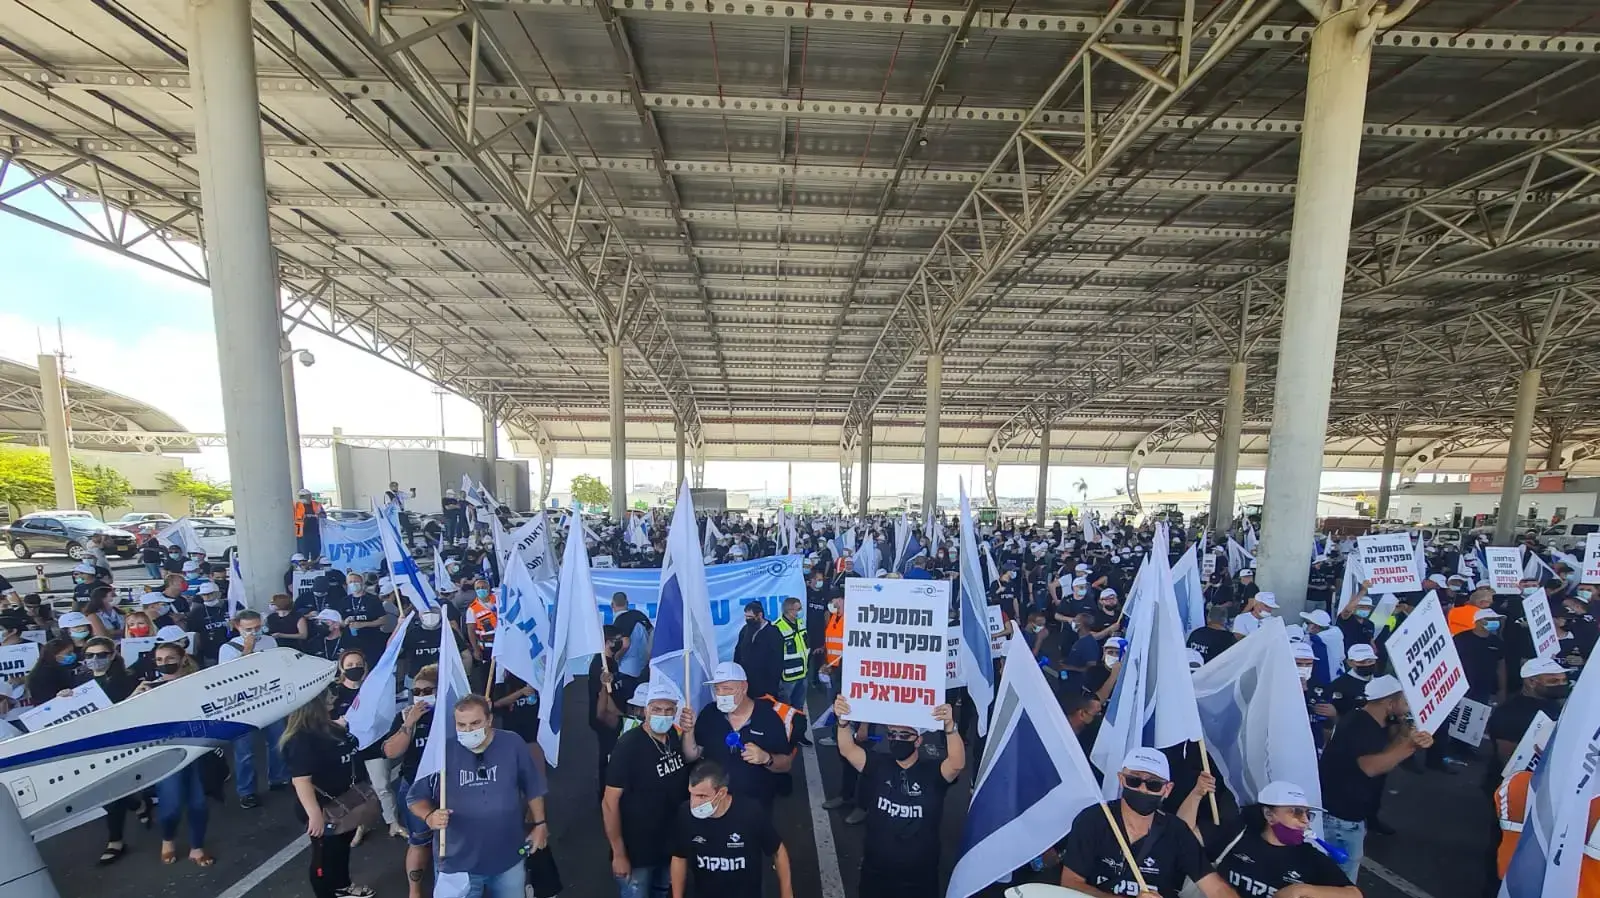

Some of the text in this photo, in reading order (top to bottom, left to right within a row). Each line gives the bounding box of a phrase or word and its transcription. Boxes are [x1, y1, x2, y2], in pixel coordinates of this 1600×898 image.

[1366, 544, 1405, 554] הממשלה
[858, 604, 933, 626] הממשלה
[848, 630, 942, 653] מפקירה את
[1406, 622, 1436, 664] תעופה
[860, 660, 926, 681] התעופה
[1408, 658, 1424, 687] לבן
[1421, 660, 1448, 698] במקום
[850, 682, 936, 706] הישראלית
[1419, 667, 1460, 723] תעופה זרה
[460, 770, 474, 786] OLD
[697, 854, 745, 871] הופקרנ
